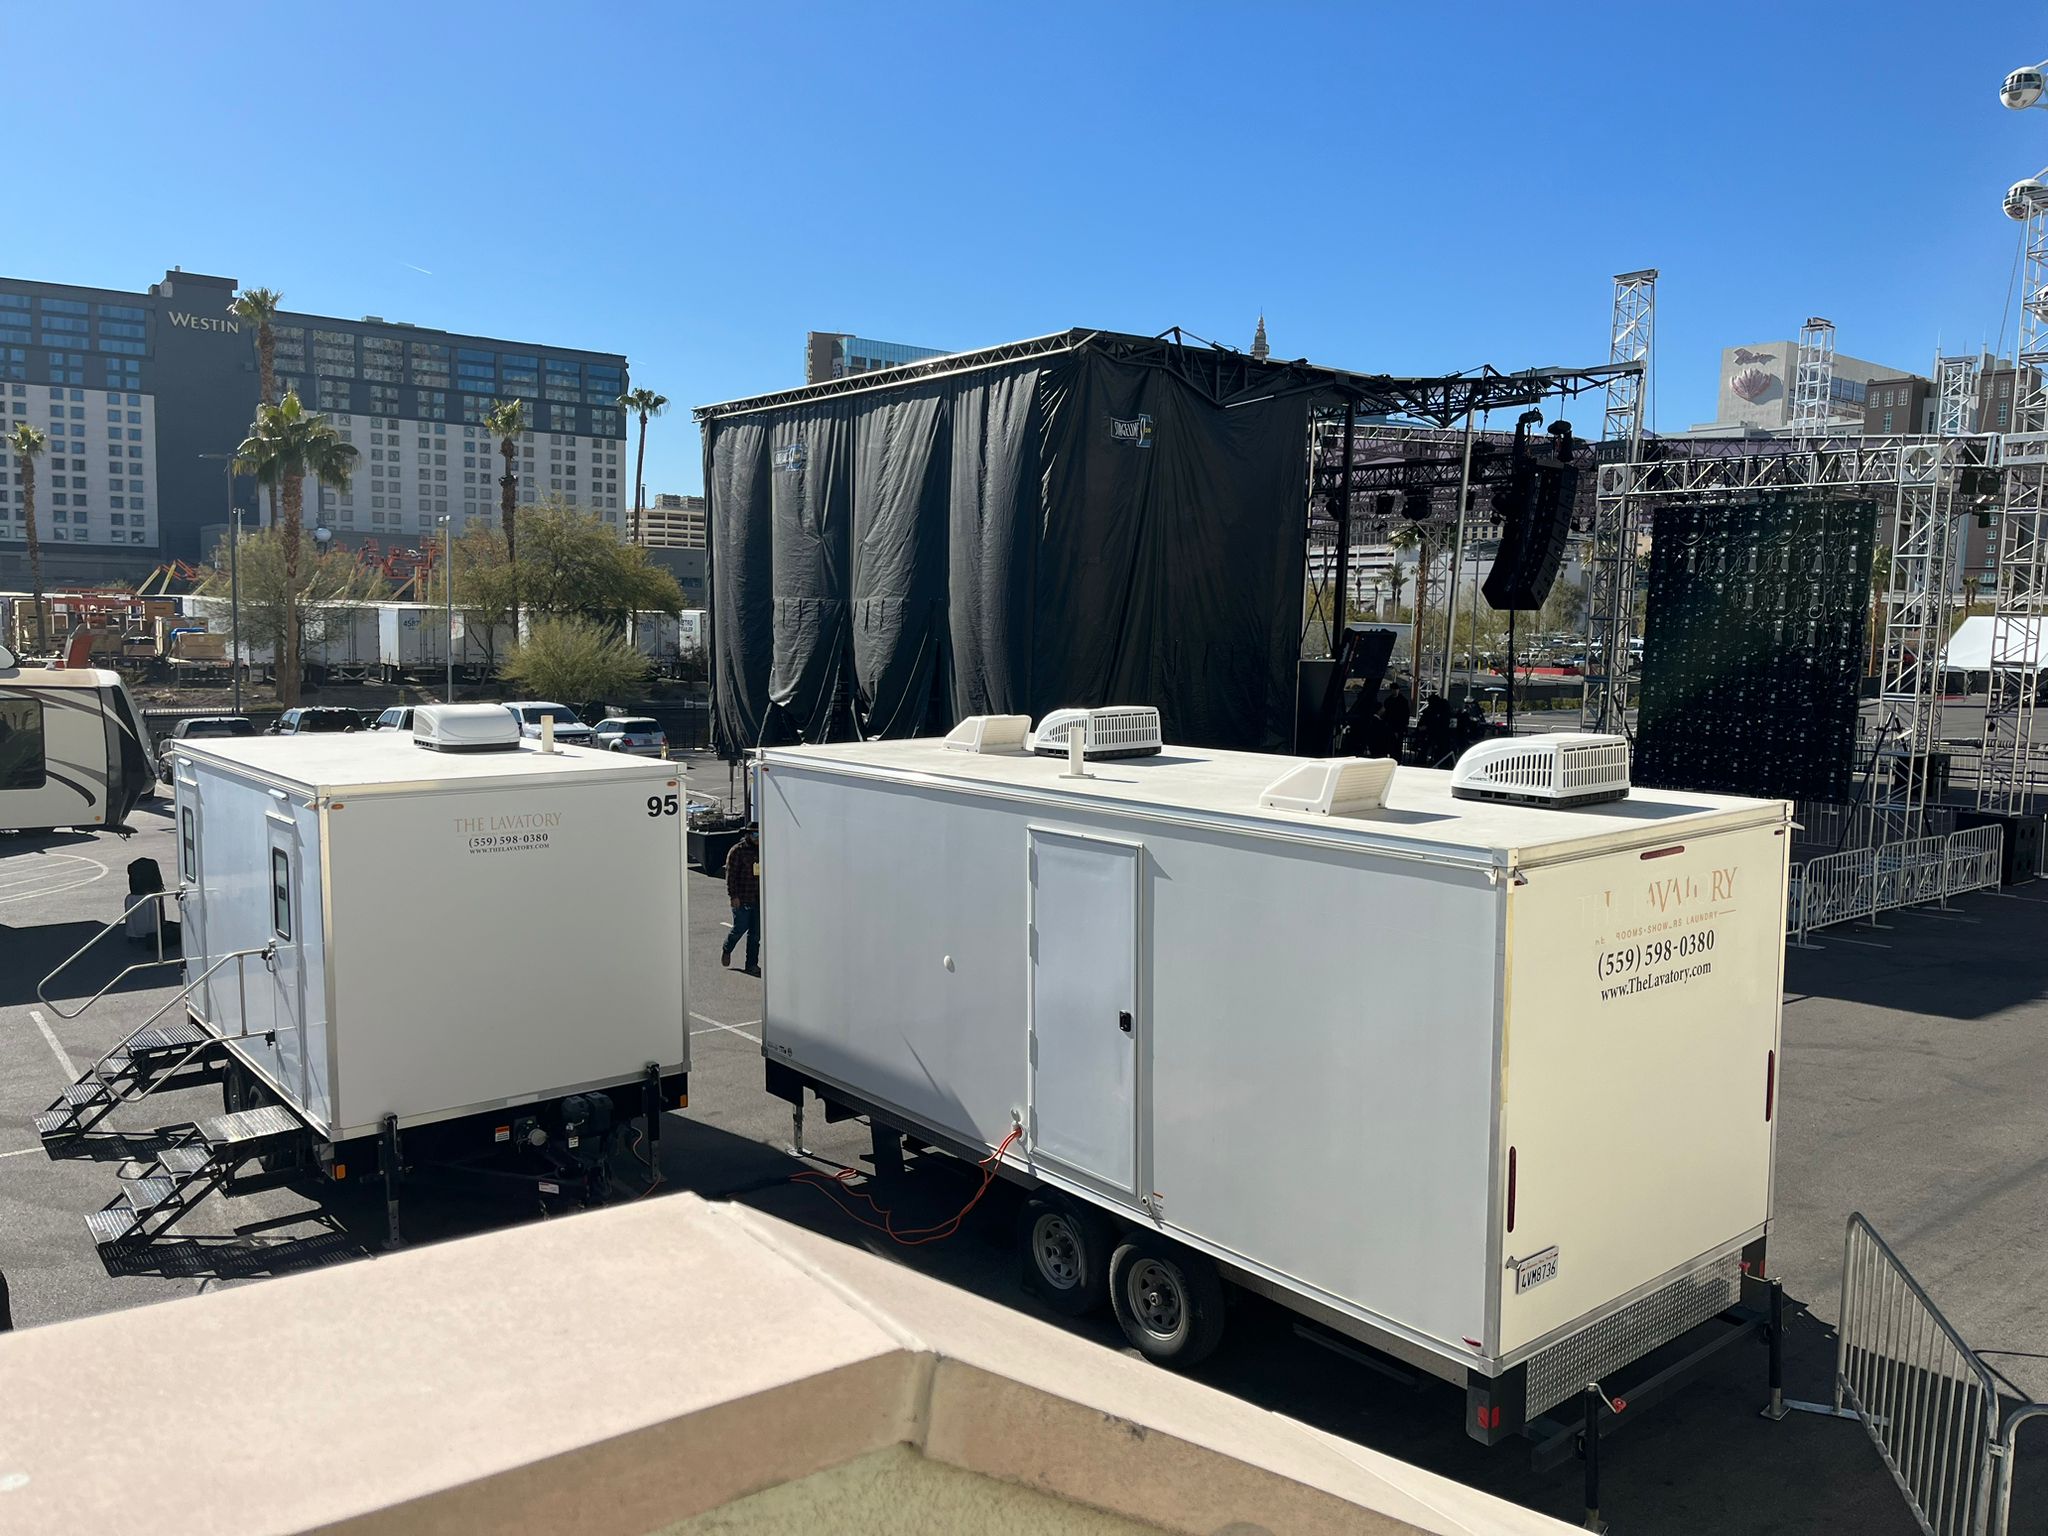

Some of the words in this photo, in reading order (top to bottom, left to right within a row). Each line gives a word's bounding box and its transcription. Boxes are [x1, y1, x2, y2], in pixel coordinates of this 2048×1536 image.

[168, 311, 239, 334] WESTIN
[647, 794, 679, 817] 95
[454, 816, 485, 833] THE
[490, 812, 562, 831] LAVATORY
[468, 835, 497, 848] (559)
[499, 833, 549, 845] 598-0380
[1686, 911, 1718, 926] LAUNDRY
[1598, 944, 1641, 981] (559)
[1644, 929, 1715, 967] 598-0380
[1600, 962, 1712, 1001] www.TheLavatory.com
